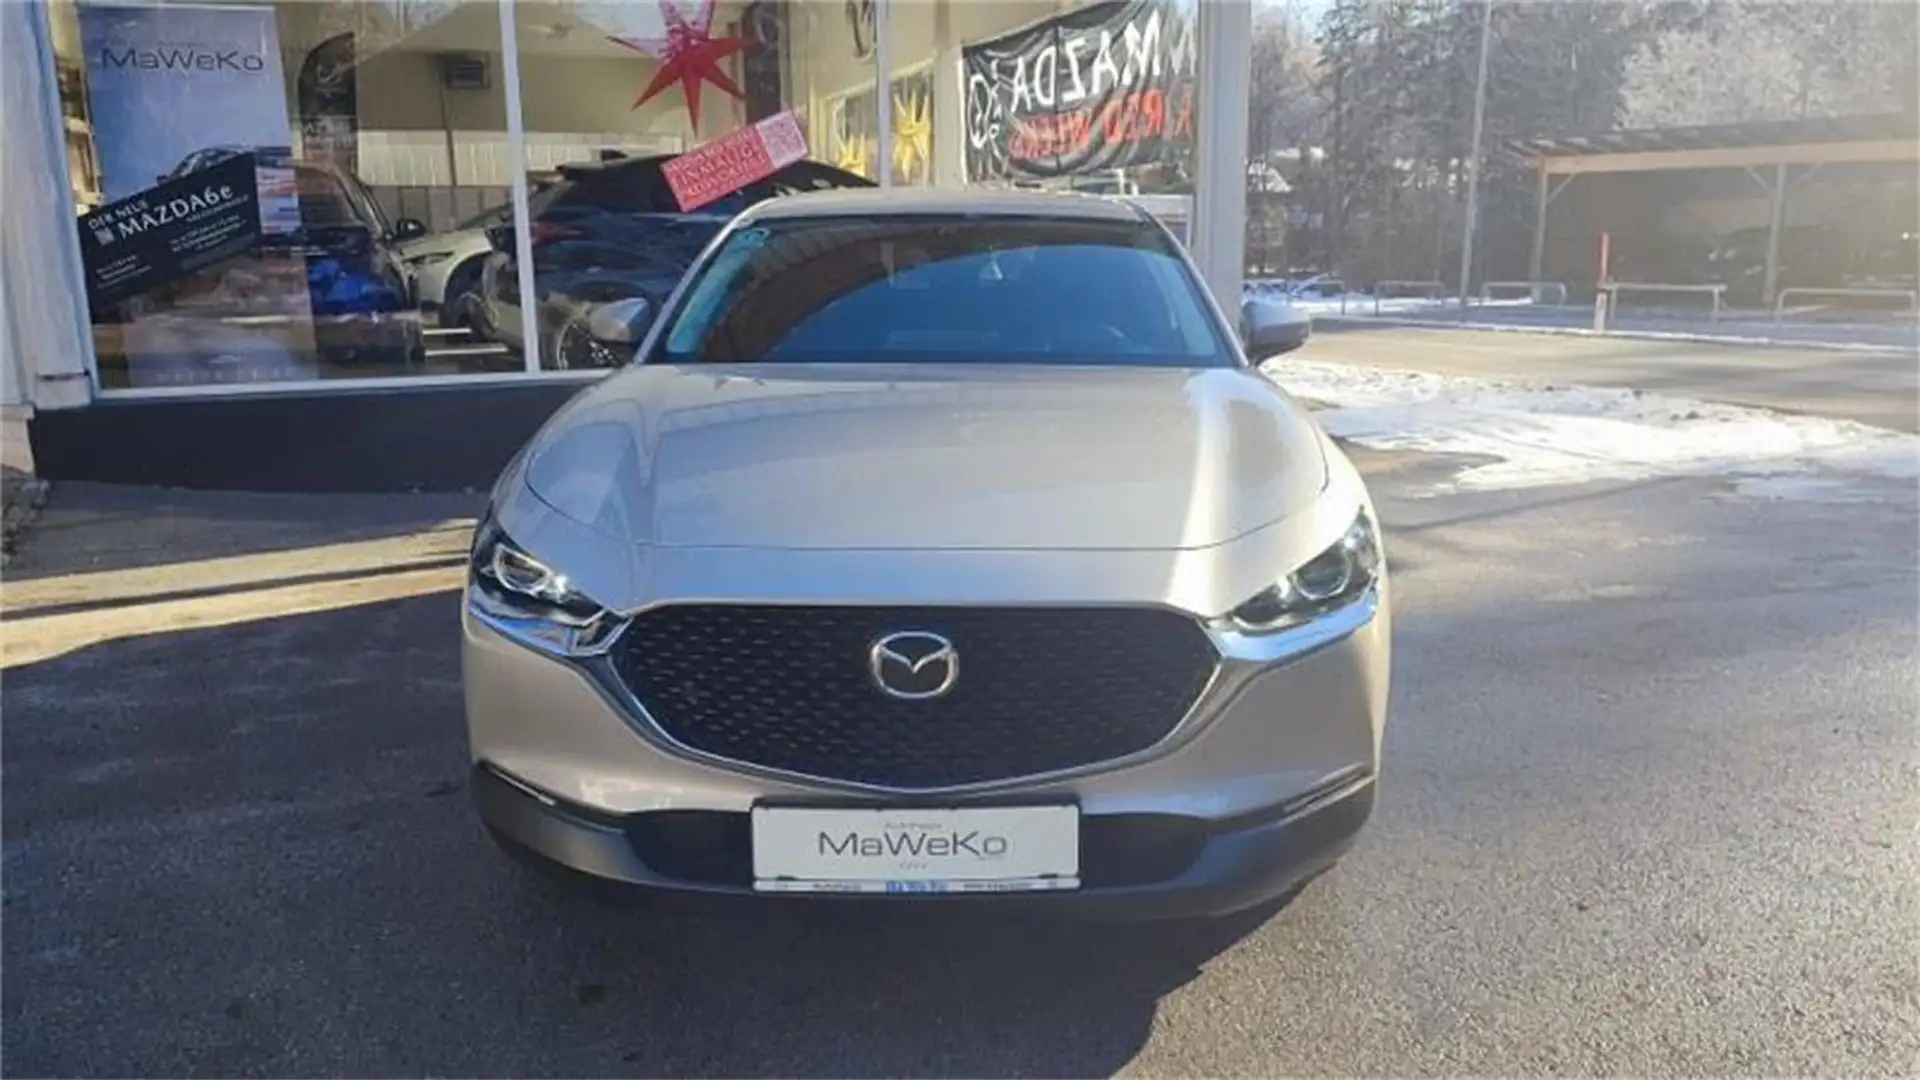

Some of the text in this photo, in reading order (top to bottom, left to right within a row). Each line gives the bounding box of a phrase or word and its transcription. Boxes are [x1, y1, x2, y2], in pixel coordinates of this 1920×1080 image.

[102, 48, 264, 71] MaWeKo
[117, 184, 234, 241] MAZDA6e
[819, 831, 1008, 857] MaWeKo
